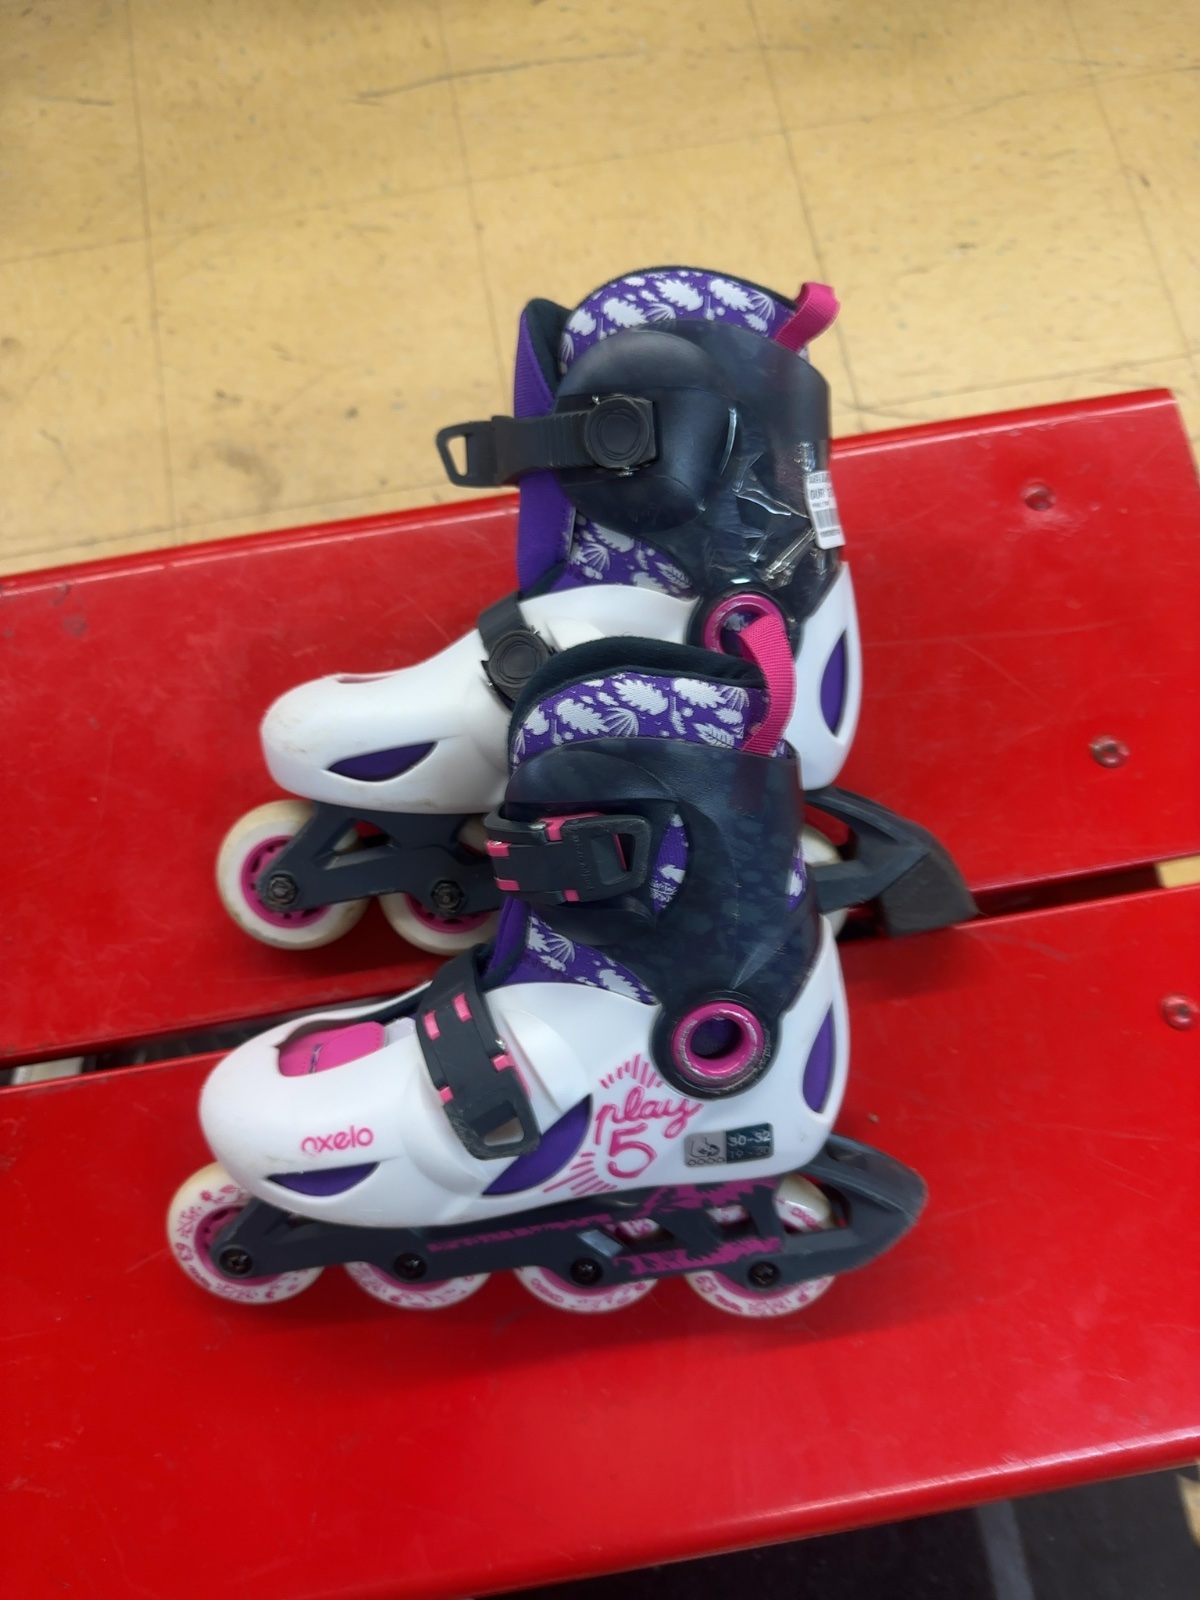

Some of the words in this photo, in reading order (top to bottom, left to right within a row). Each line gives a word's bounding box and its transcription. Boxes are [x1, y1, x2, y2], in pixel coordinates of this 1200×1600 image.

[595, 1085, 704, 1145] play
[727, 1129, 772, 1147] 30-32
[607, 1122, 658, 1178] 5
